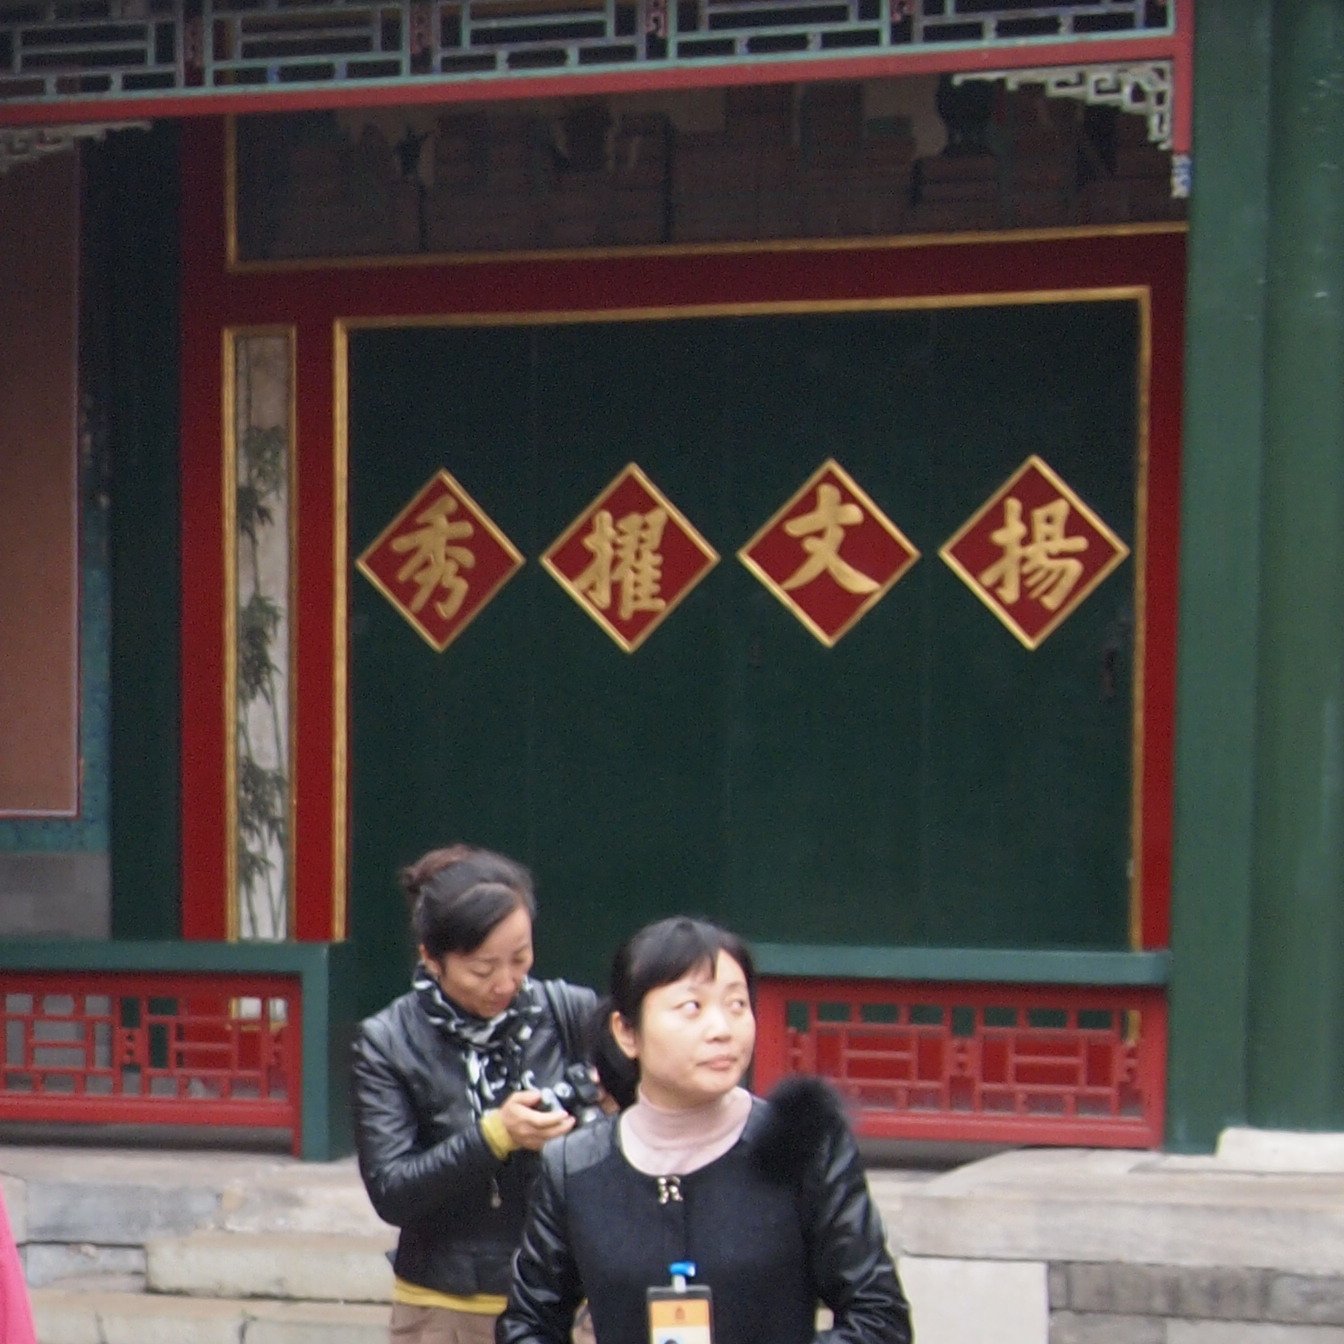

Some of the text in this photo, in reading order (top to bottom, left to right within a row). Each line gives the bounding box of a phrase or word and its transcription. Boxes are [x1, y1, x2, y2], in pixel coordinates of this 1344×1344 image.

[391, 495, 475, 618] 秀
[782, 484, 879, 596] 文
[980, 497, 1089, 611] 揚
